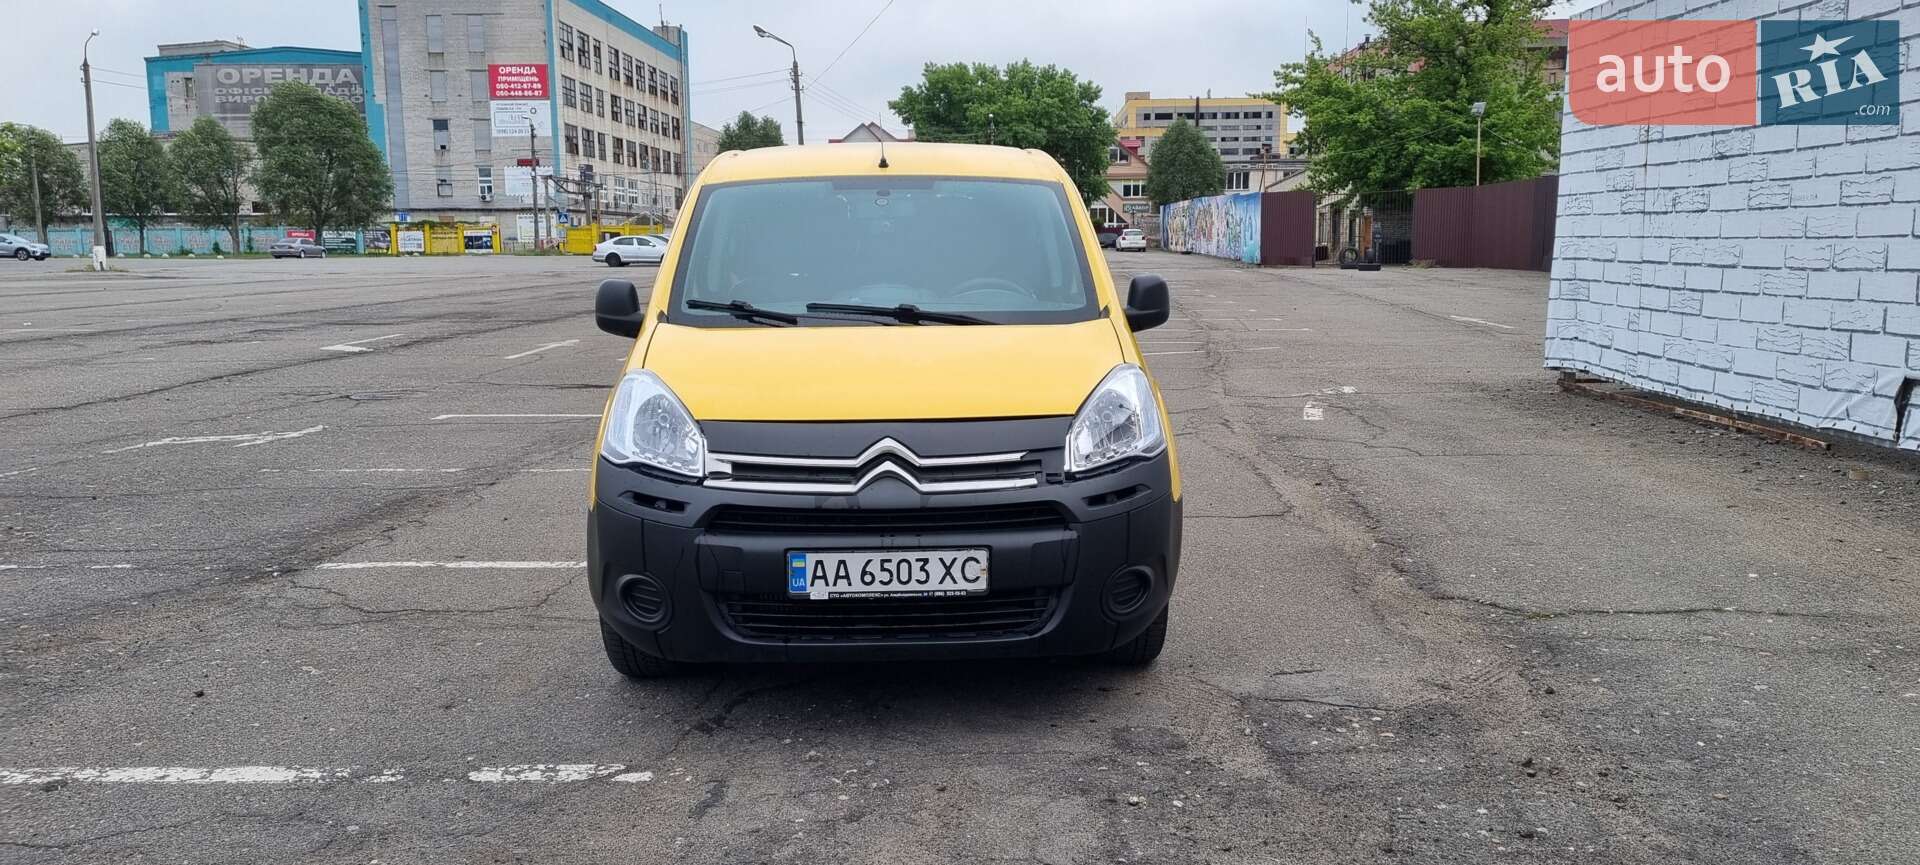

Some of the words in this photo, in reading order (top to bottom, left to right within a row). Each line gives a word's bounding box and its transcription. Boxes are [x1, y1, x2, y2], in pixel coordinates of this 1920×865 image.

[217, 68, 358, 86] ОРЕНДА
[498, 66, 537, 75] ОРЕНДА
[810, 559, 852, 587] AA
[860, 558, 930, 586] 6503
[938, 556, 982, 585] XC
[792, 578, 806, 587] UA
